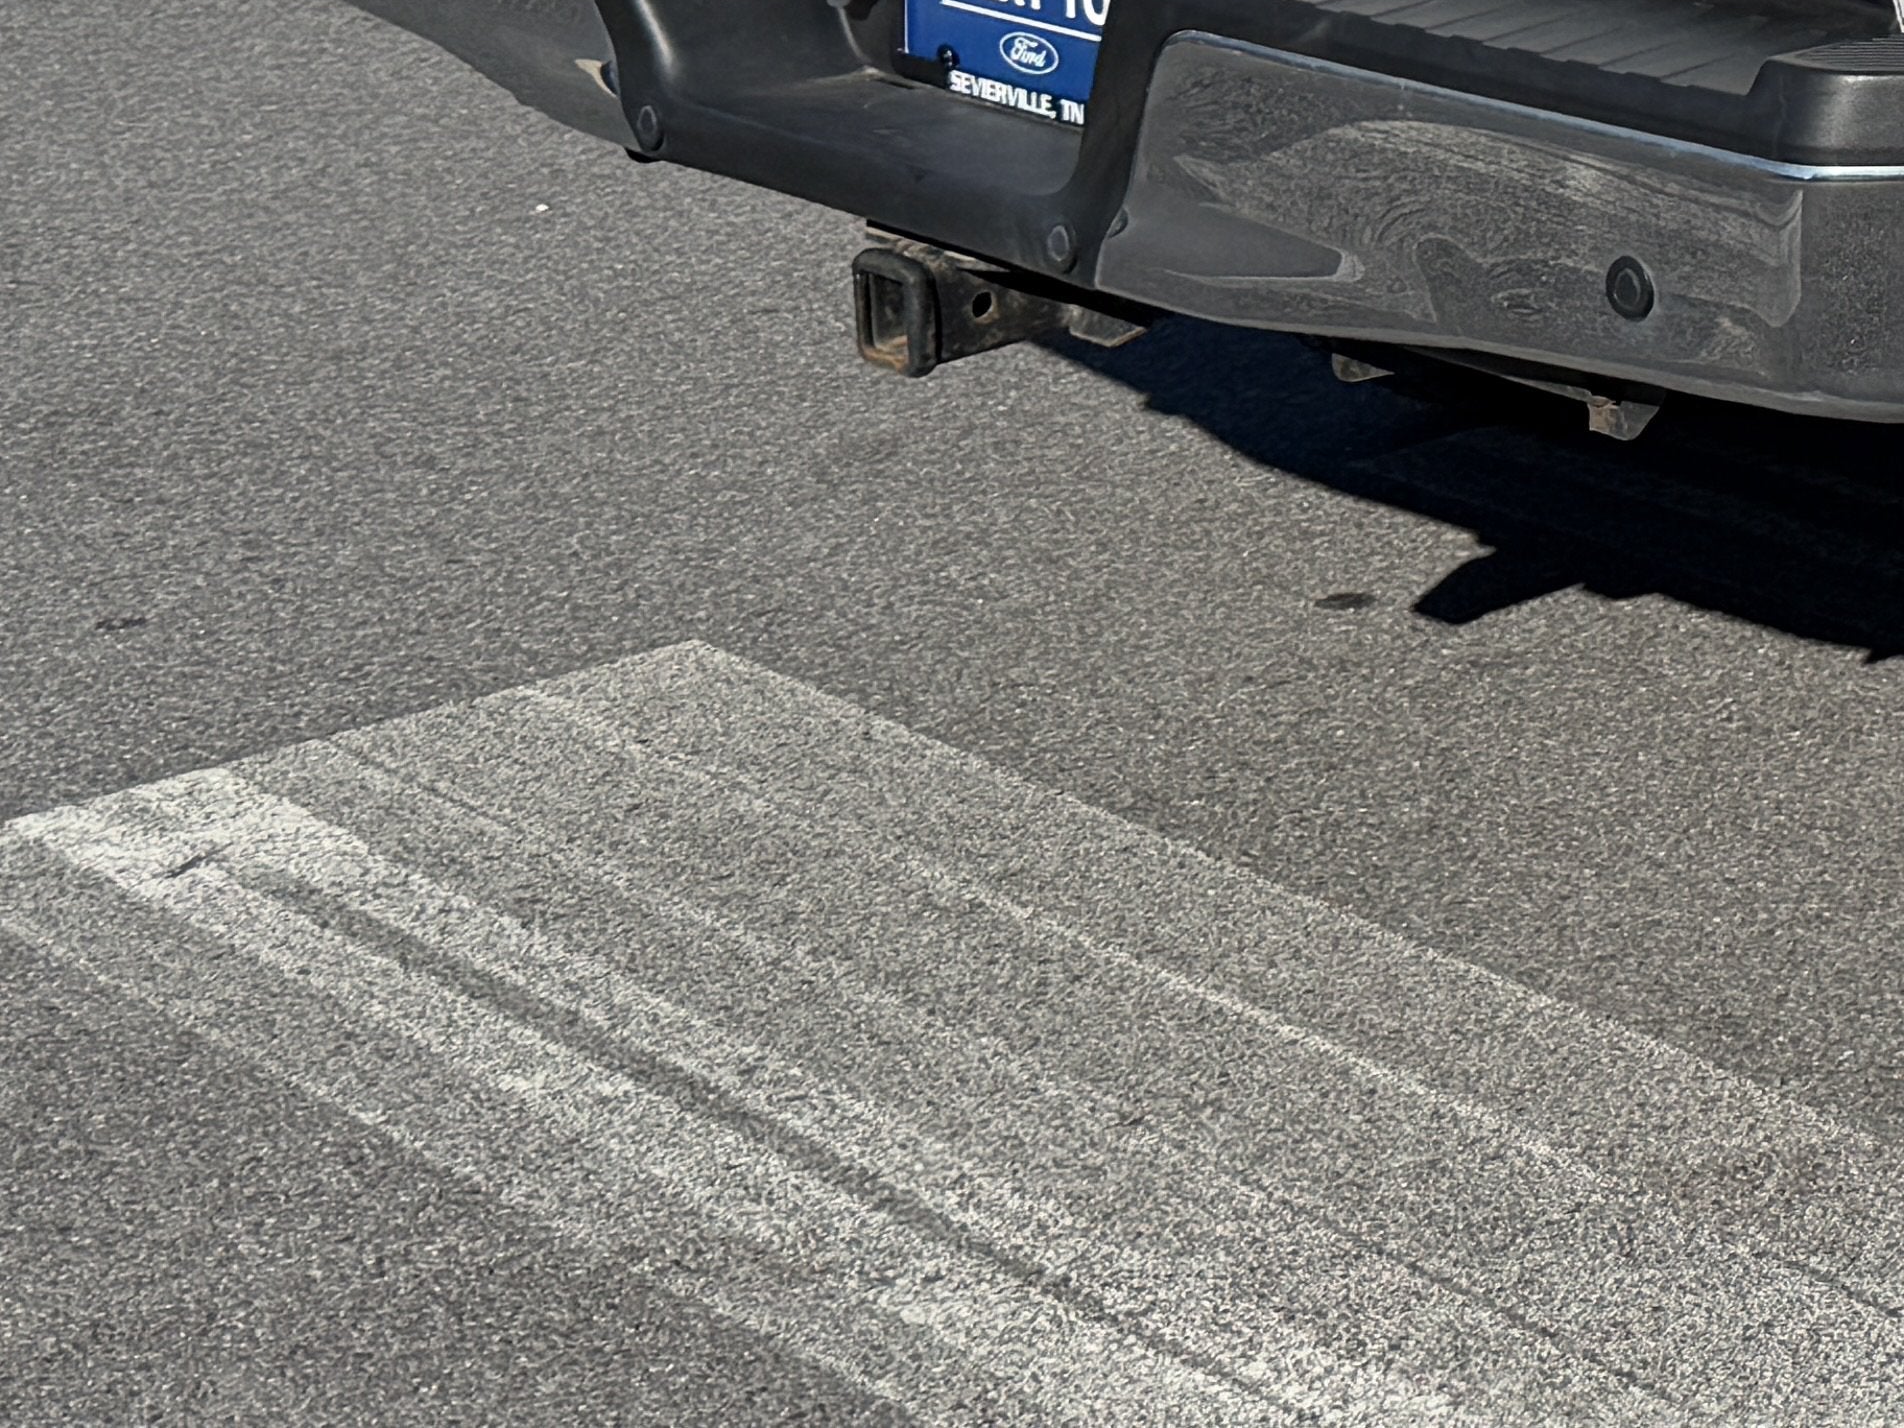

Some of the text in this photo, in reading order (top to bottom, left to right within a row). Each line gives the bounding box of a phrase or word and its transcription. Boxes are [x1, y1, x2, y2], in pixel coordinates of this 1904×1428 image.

[1010, 37, 1046, 68] Ford
[950, 69, 1085, 125] SEVIERVILLE, TN
